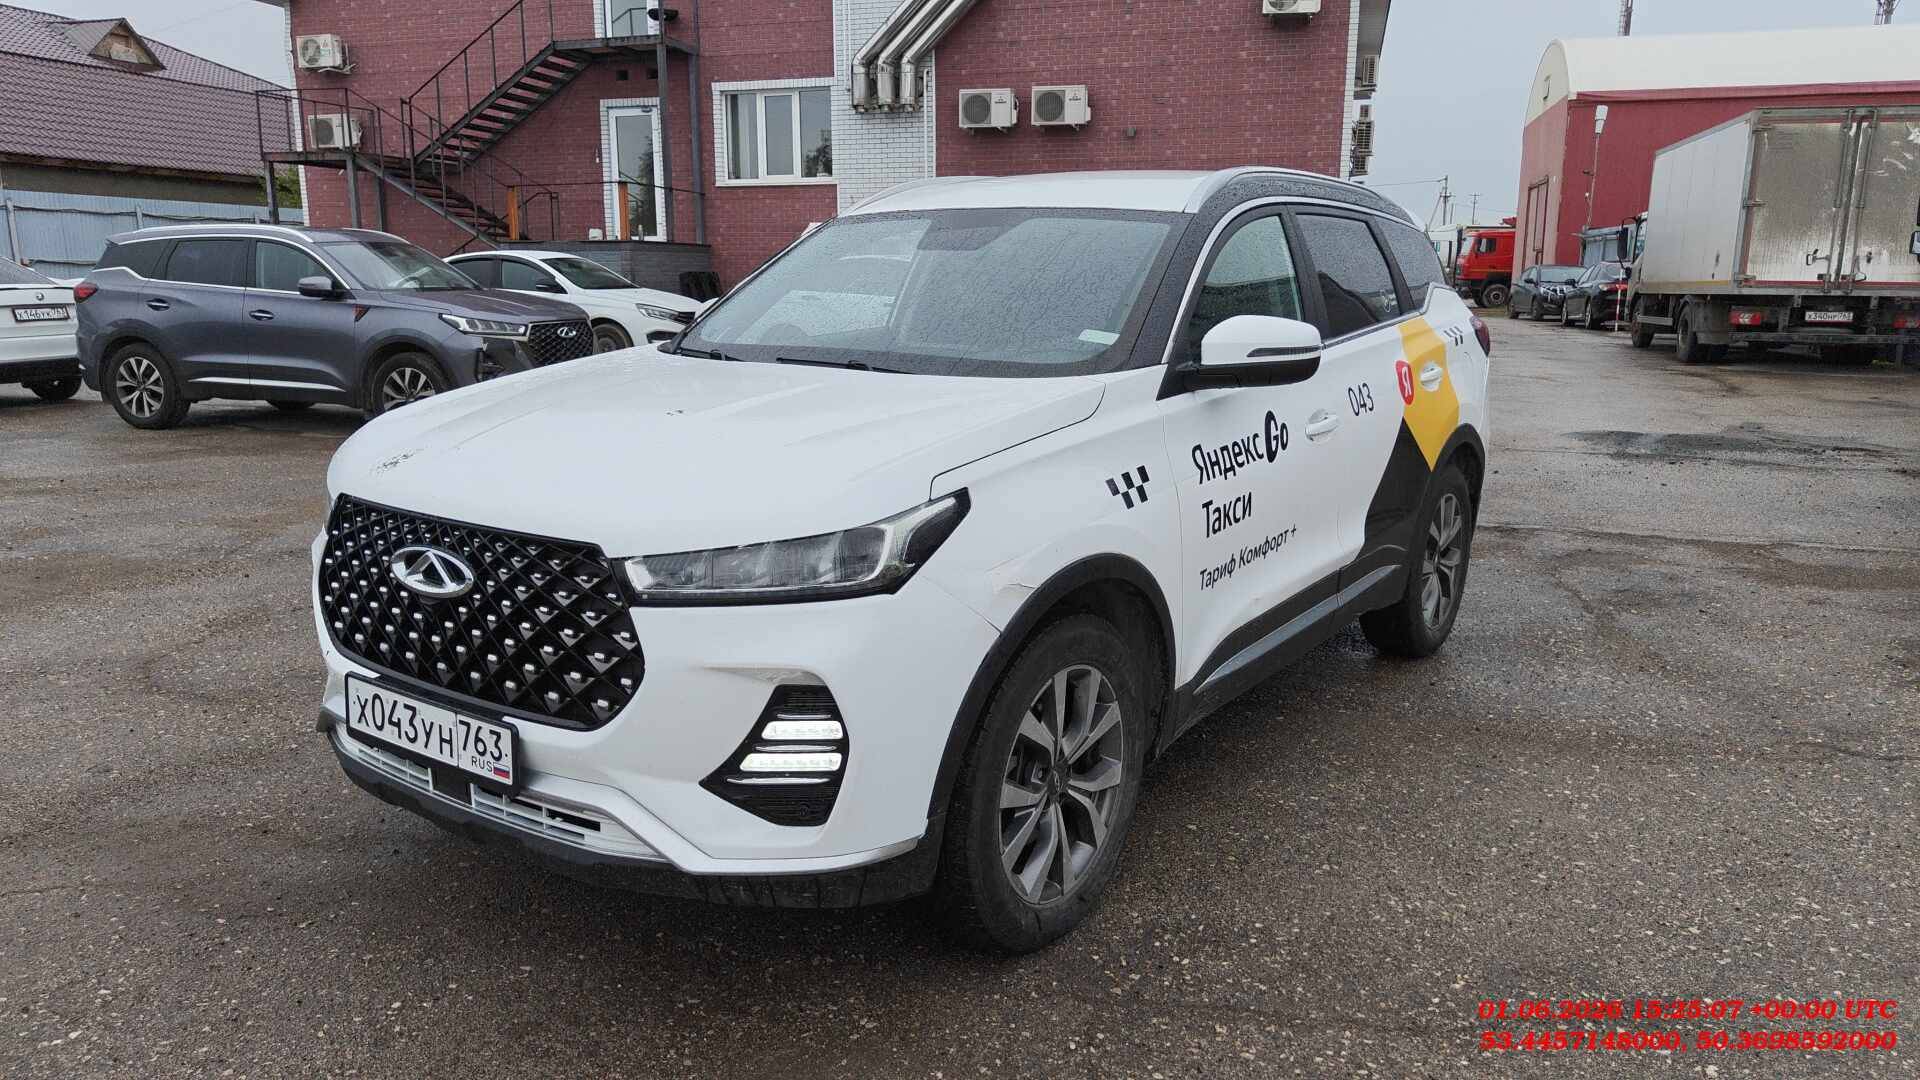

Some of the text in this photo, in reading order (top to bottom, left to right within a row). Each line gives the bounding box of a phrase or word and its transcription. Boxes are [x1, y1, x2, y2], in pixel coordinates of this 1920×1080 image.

[1348, 382, 1374, 416] 043
[1402, 366, 1411, 398] Я
[1192, 410, 1288, 485] Яндекс Go
[1202, 492, 1252, 538] Такси
[1200, 553, 1236, 590] Тариф
[1239, 529, 1289, 569] Комфорт
[356, 693, 503, 762] Х043УН 763
[471, 755, 493, 772] RUS
